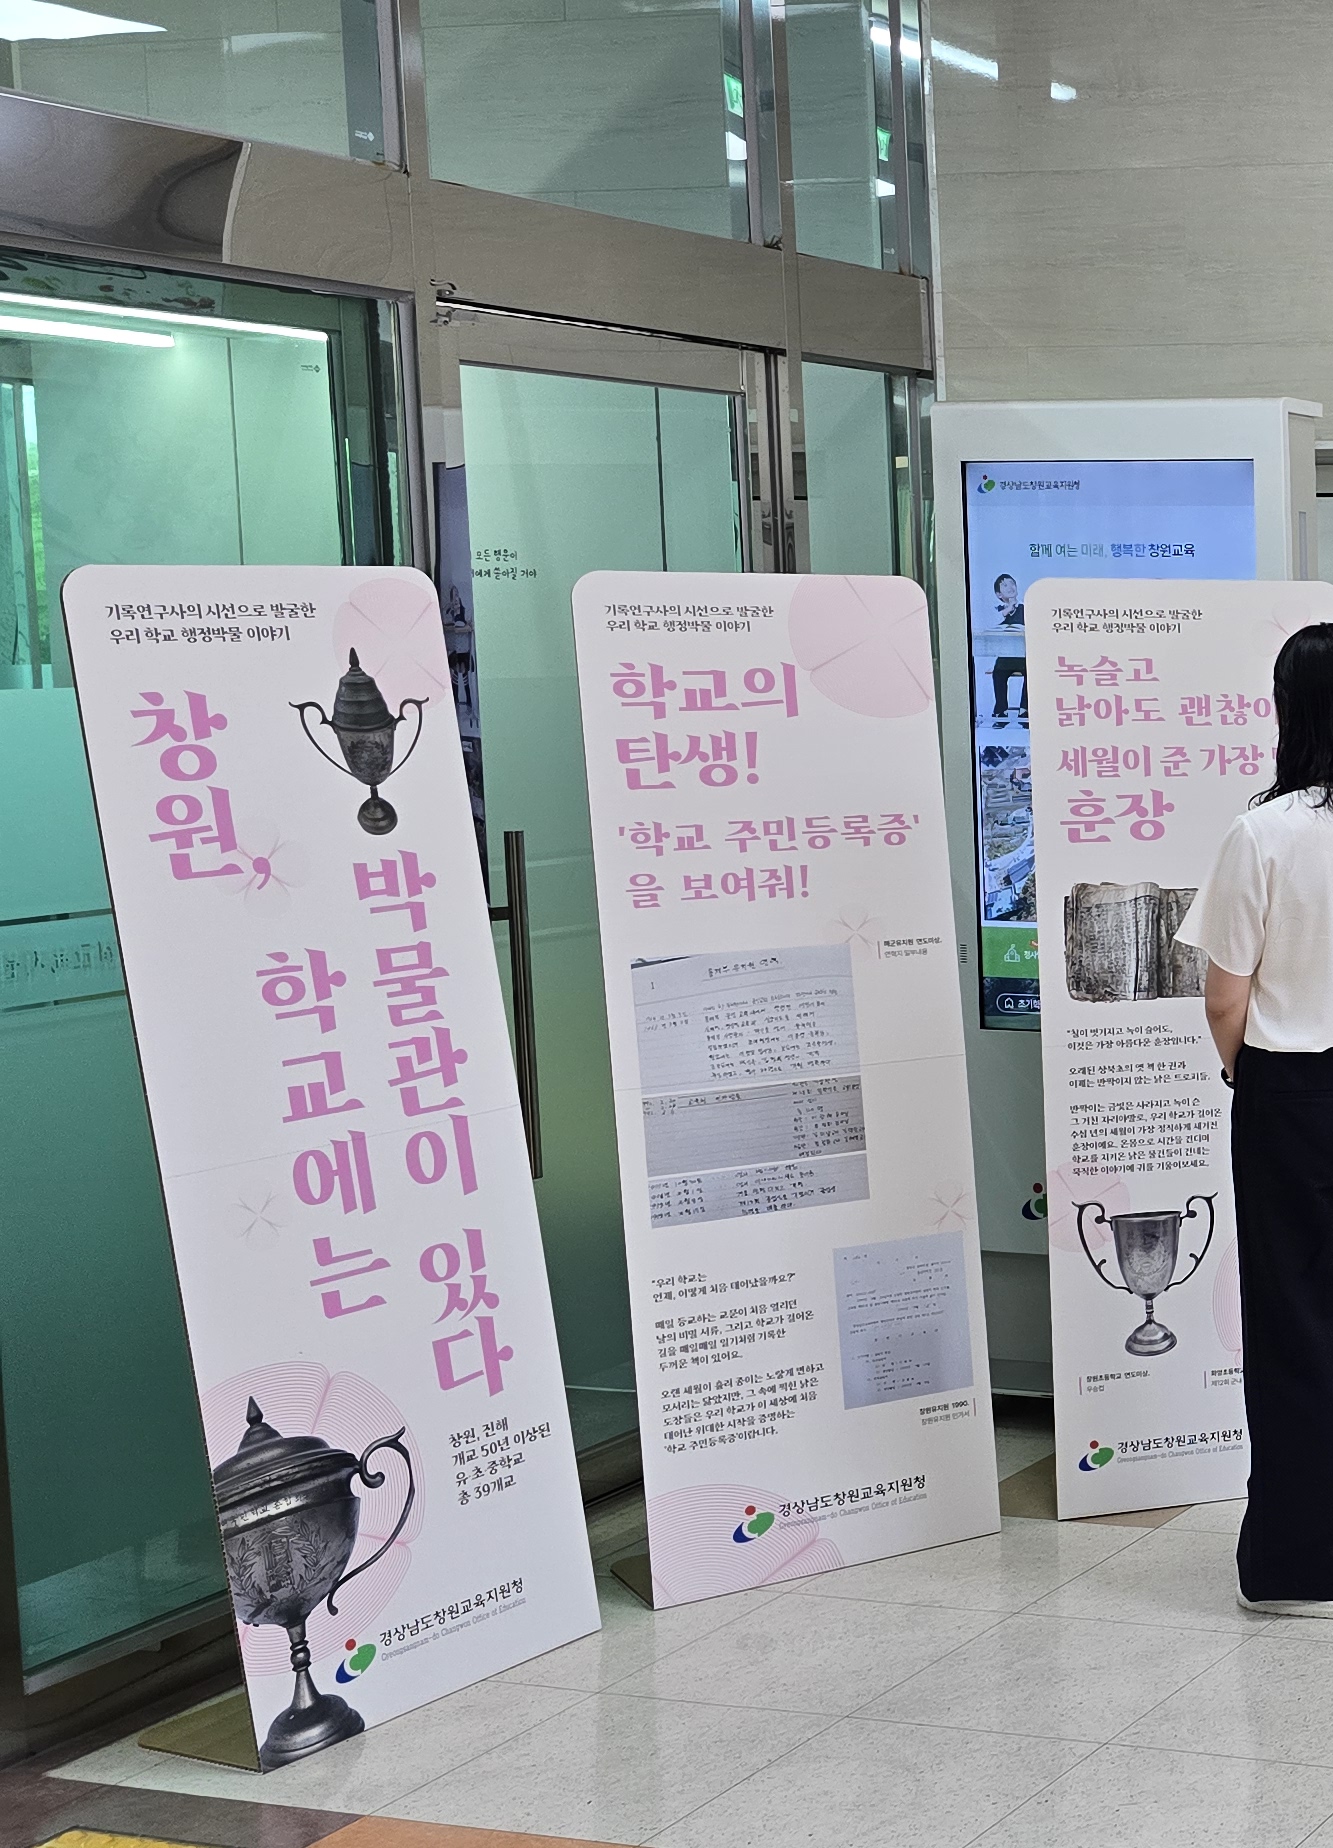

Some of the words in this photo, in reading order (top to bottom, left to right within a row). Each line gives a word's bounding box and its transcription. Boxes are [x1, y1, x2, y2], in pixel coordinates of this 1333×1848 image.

[475, 548, 491, 563] 모든
[1053, 542, 1079, 559] 여는
[1079, 542, 1110, 559] 미래,
[1108, 542, 1147, 560] 행복한
[1145, 541, 1197, 560] 창원교육
[470, 567, 491, 581] 에게
[105, 603, 203, 621] 기록연구사의
[205, 602, 268, 620] 시선으로
[269, 602, 317, 619] 발굴한
[109, 627, 141, 645] 우리
[143, 627, 179, 644] 학교
[180, 626, 243, 644] 행정박물
[246, 625, 291, 642] 이야기
[1054, 656, 1159, 686] 녹슬고
[610, 662, 798, 720] 학교의
[1056, 694, 1165, 727] 낡아도
[616, 730, 759, 790] 탄생!
[1057, 745, 1151, 778] 세월이
[1160, 747, 1191, 777] 준
[1200, 744, 1264, 776] 가장
[130, 689, 272, 890] 창원,
[619, 822, 711, 856] '학교
[725, 814, 919, 853] 주민등록증'
[1060, 789, 1174, 843] 훈장
[626, 874, 664, 908] 을
[681, 865, 809, 902] 보여줘!
[255, 948, 392, 1320] 학교에는
[352, 849, 480, 1196] 박물관이
[418, 1228, 514, 1398] 있다
[448, 1427, 480, 1449] 창원,
[482, 1416, 509, 1439] 진해
[452, 1448, 479, 1466] 개교
[480, 1435, 511, 1458] 50년
[513, 1421, 551, 1445] 이상된
[1118, 1429, 1242, 1453] 경상남도창원교육지원청
[457, 1489, 471, 1506] 총
[473, 1474, 517, 1500] 39개교
[779, 1475, 925, 1517] 경상남도창원교육지원청
[380, 1578, 522, 1646] 경상남도창원교육지원청
